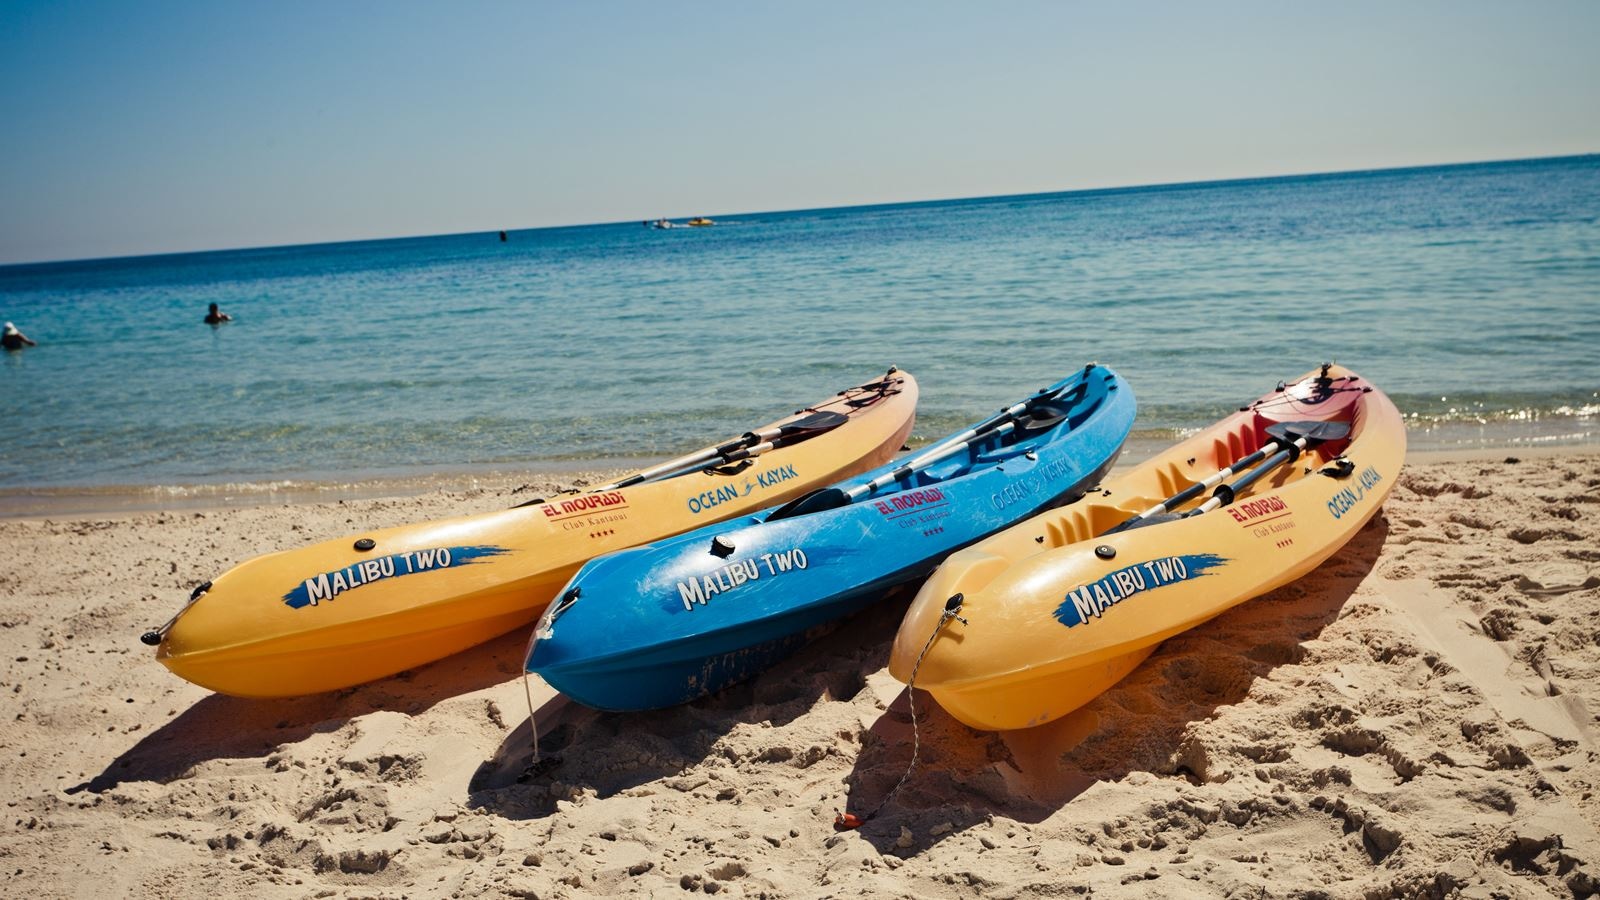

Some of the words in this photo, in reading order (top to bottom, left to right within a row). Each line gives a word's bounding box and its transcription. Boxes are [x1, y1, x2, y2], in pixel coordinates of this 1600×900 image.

[688, 483, 739, 514] OCEAN
[756, 463, 799, 489] KAYAK
[991, 479, 1031, 511] OCEAN
[1327, 486, 1358, 519] OCEAN
[541, 504, 562, 517] EL
[562, 520, 585, 531] Club
[587, 513, 628, 527] Kantaoui
[874, 501, 895, 515] EL
[1227, 508, 1248, 523] EL
[305, 556, 395, 606] MALIBU
[400, 548, 452, 573] TWO
[676, 558, 760, 612] MALIBU
[760, 548, 809, 576] TWO
[1068, 566, 1147, 625] MALIBU
[1143, 556, 1188, 587] TWO
